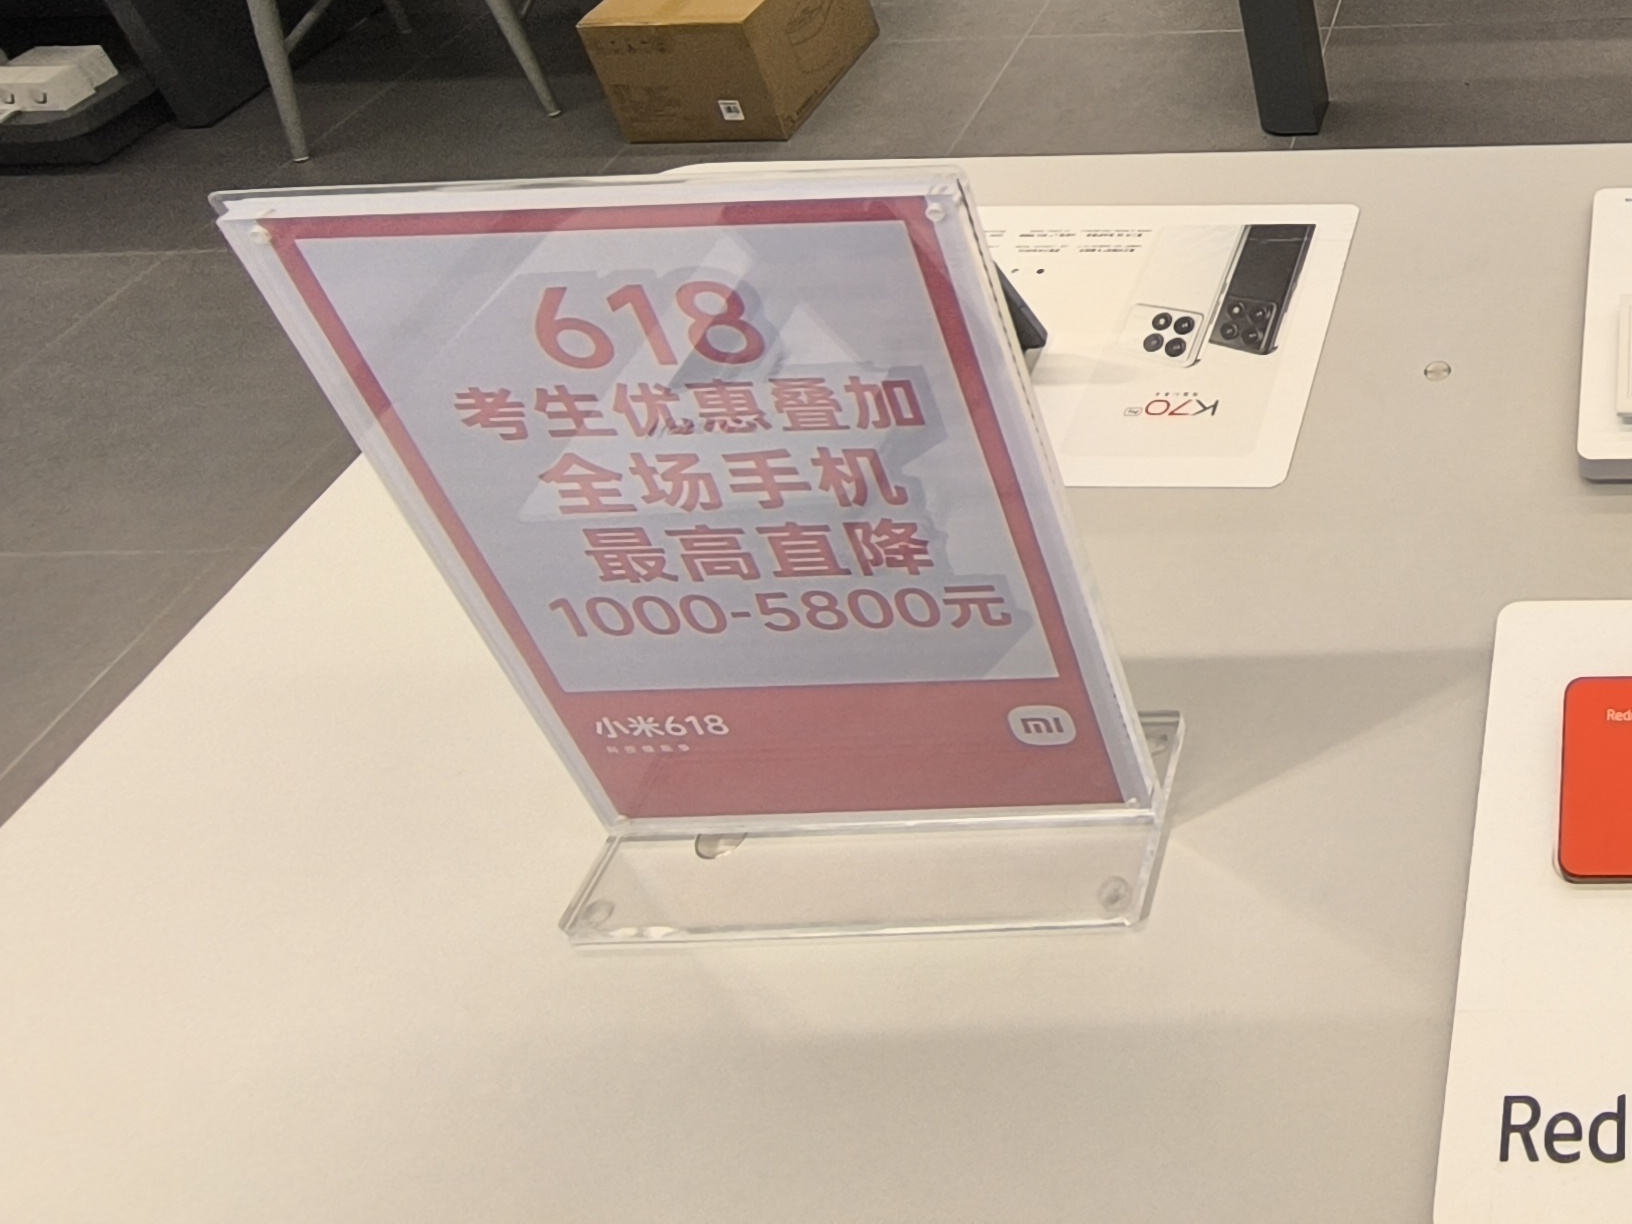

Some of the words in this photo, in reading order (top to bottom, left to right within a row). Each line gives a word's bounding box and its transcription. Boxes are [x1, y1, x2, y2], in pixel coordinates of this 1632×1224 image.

[534, 279, 766, 371] 618
[454, 376, 927, 442] 考生优惠叠加
[1145, 400, 1219, 416] K70
[537, 447, 910, 516] 全场手机
[585, 519, 936, 584] 最高直降
[548, 584, 1013, 639] 1000-5800元
[595, 714, 730, 738] 小米618
